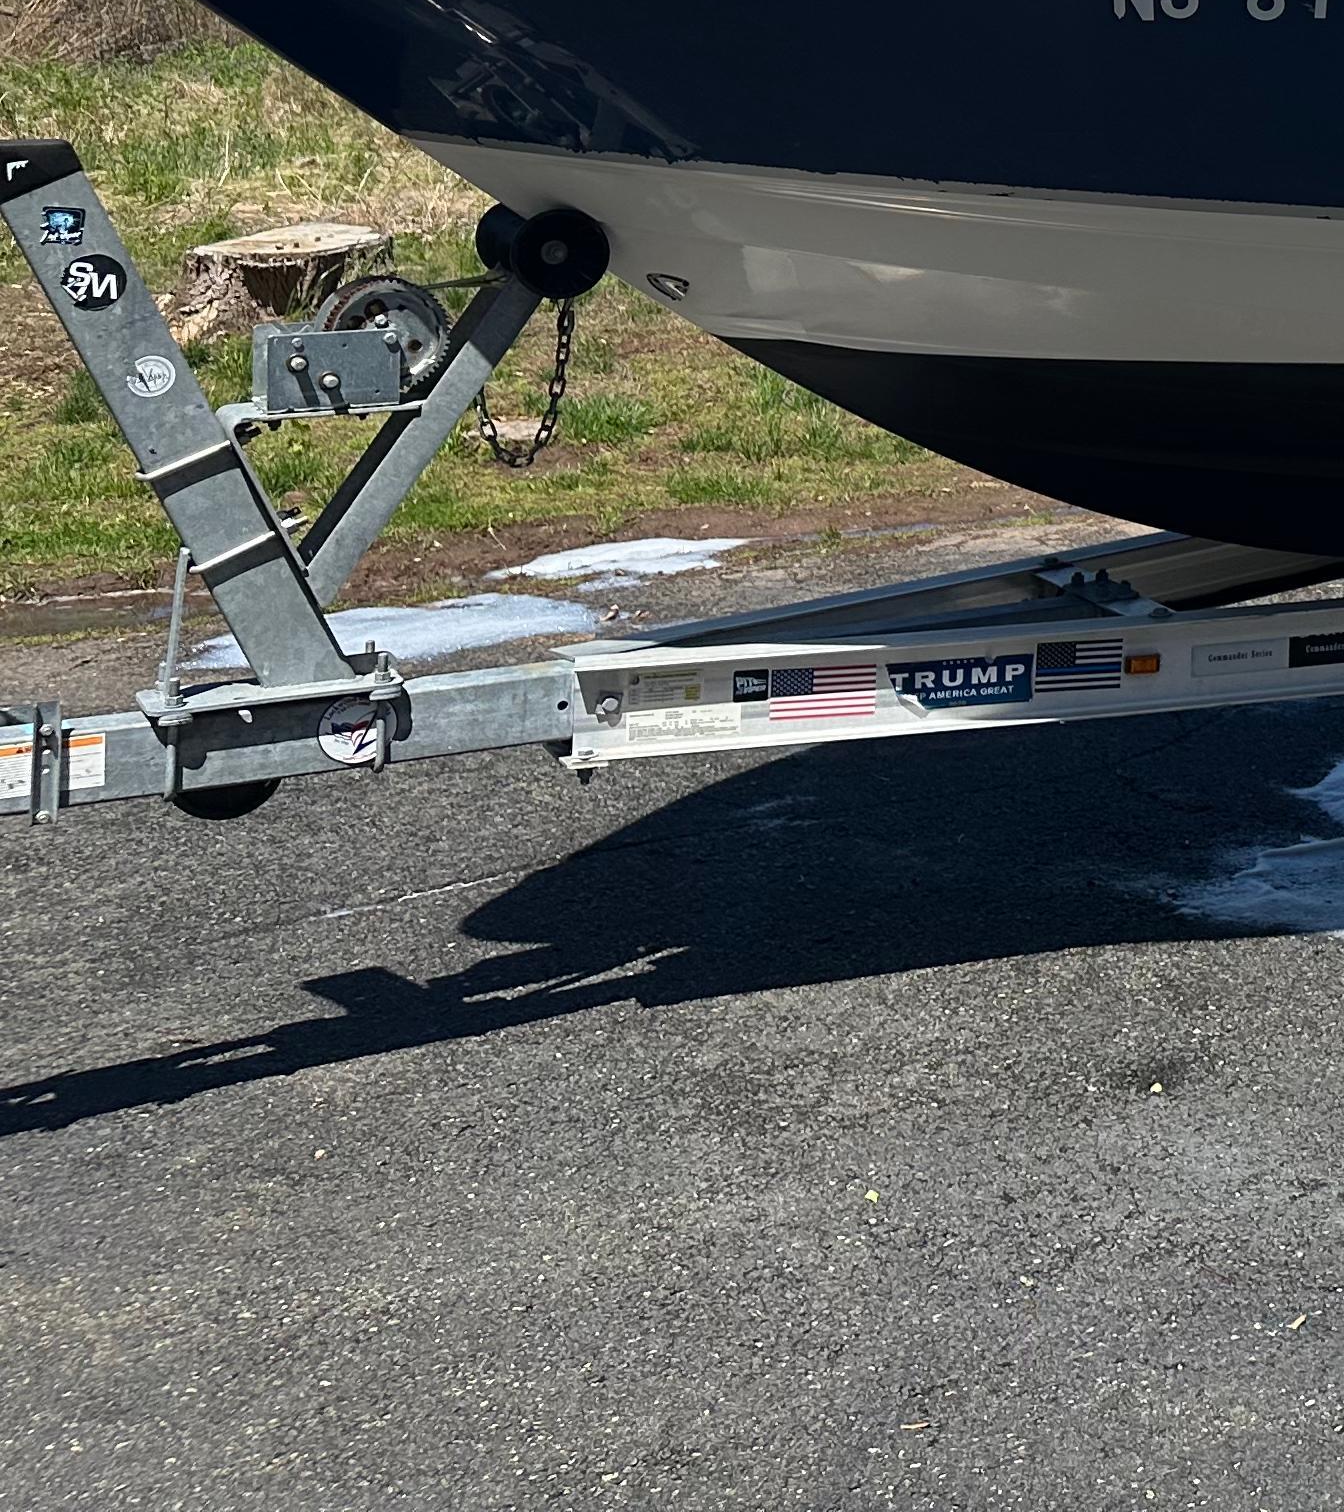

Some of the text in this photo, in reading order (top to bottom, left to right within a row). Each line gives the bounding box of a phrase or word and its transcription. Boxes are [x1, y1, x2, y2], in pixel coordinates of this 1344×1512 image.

[890, 664, 1025, 690] TRUMP
[929, 689, 977, 700] AMERICA
[980, 685, 1014, 695] GREAT
